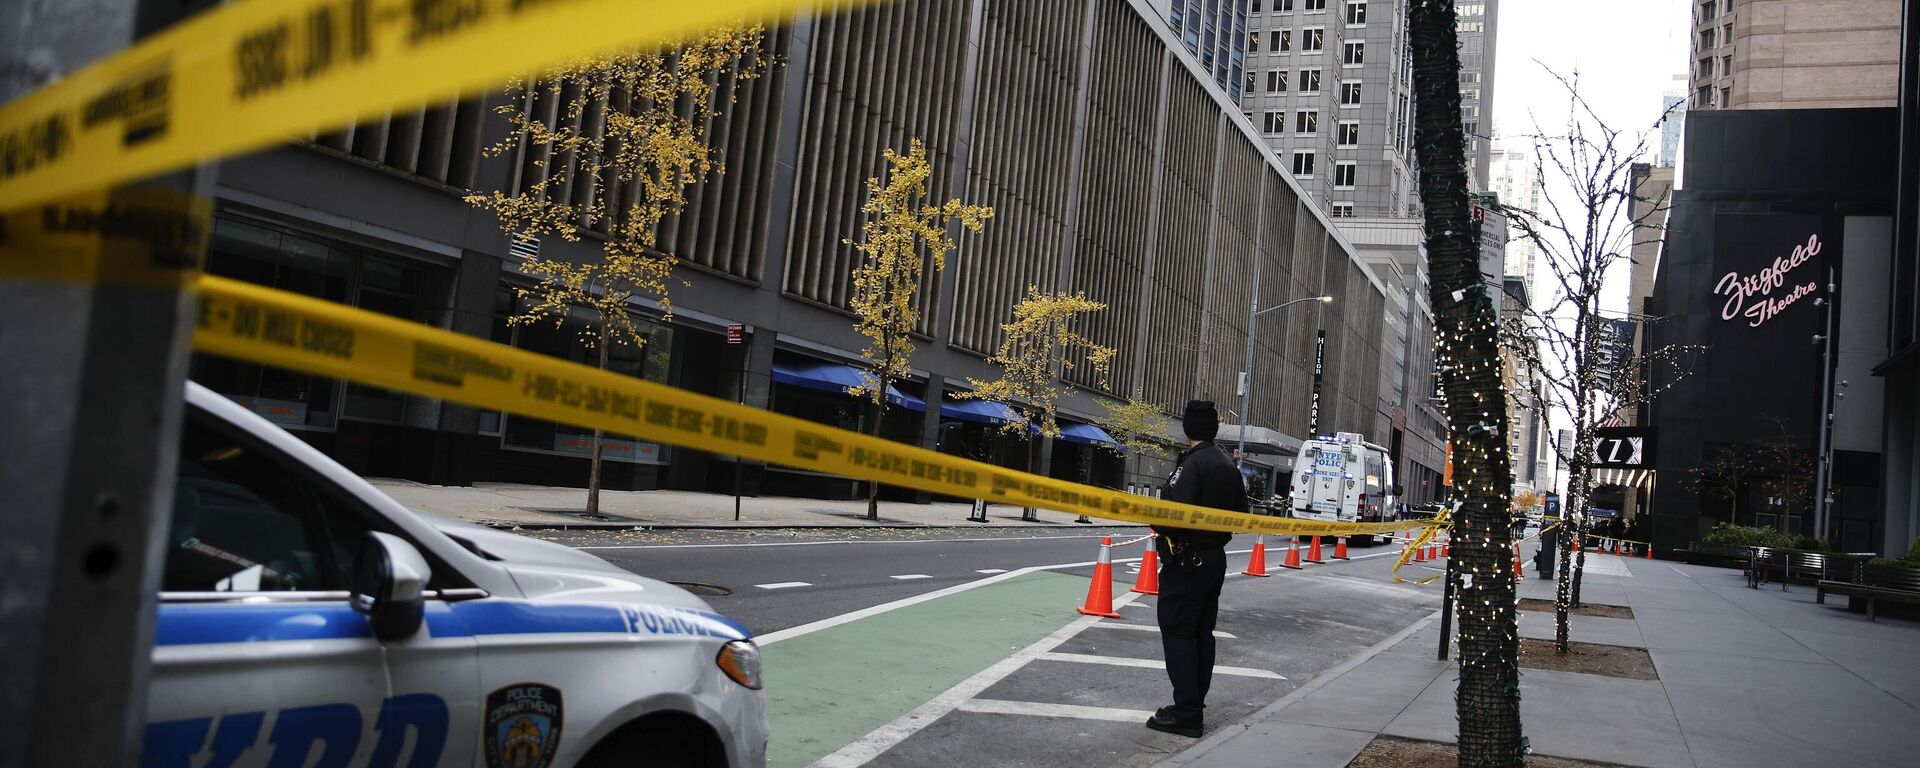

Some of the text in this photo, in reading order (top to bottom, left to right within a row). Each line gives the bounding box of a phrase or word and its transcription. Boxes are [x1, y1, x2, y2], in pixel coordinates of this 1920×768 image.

[1713, 233, 1822, 320] Ziegfeld
[1744, 281, 1817, 327] Theatre
[1315, 337, 1324, 374] Hilton
[1310, 393, 1319, 426] PARK
[1317, 452, 1343, 460] NYPD
[1607, 439, 1622, 462] Z
[1315, 459, 1343, 467] POLIC
[1549, 502, 1555, 511] P
[507, 687, 543, 701] POLICE
[491, 699, 557, 723] DEPARTMENT
